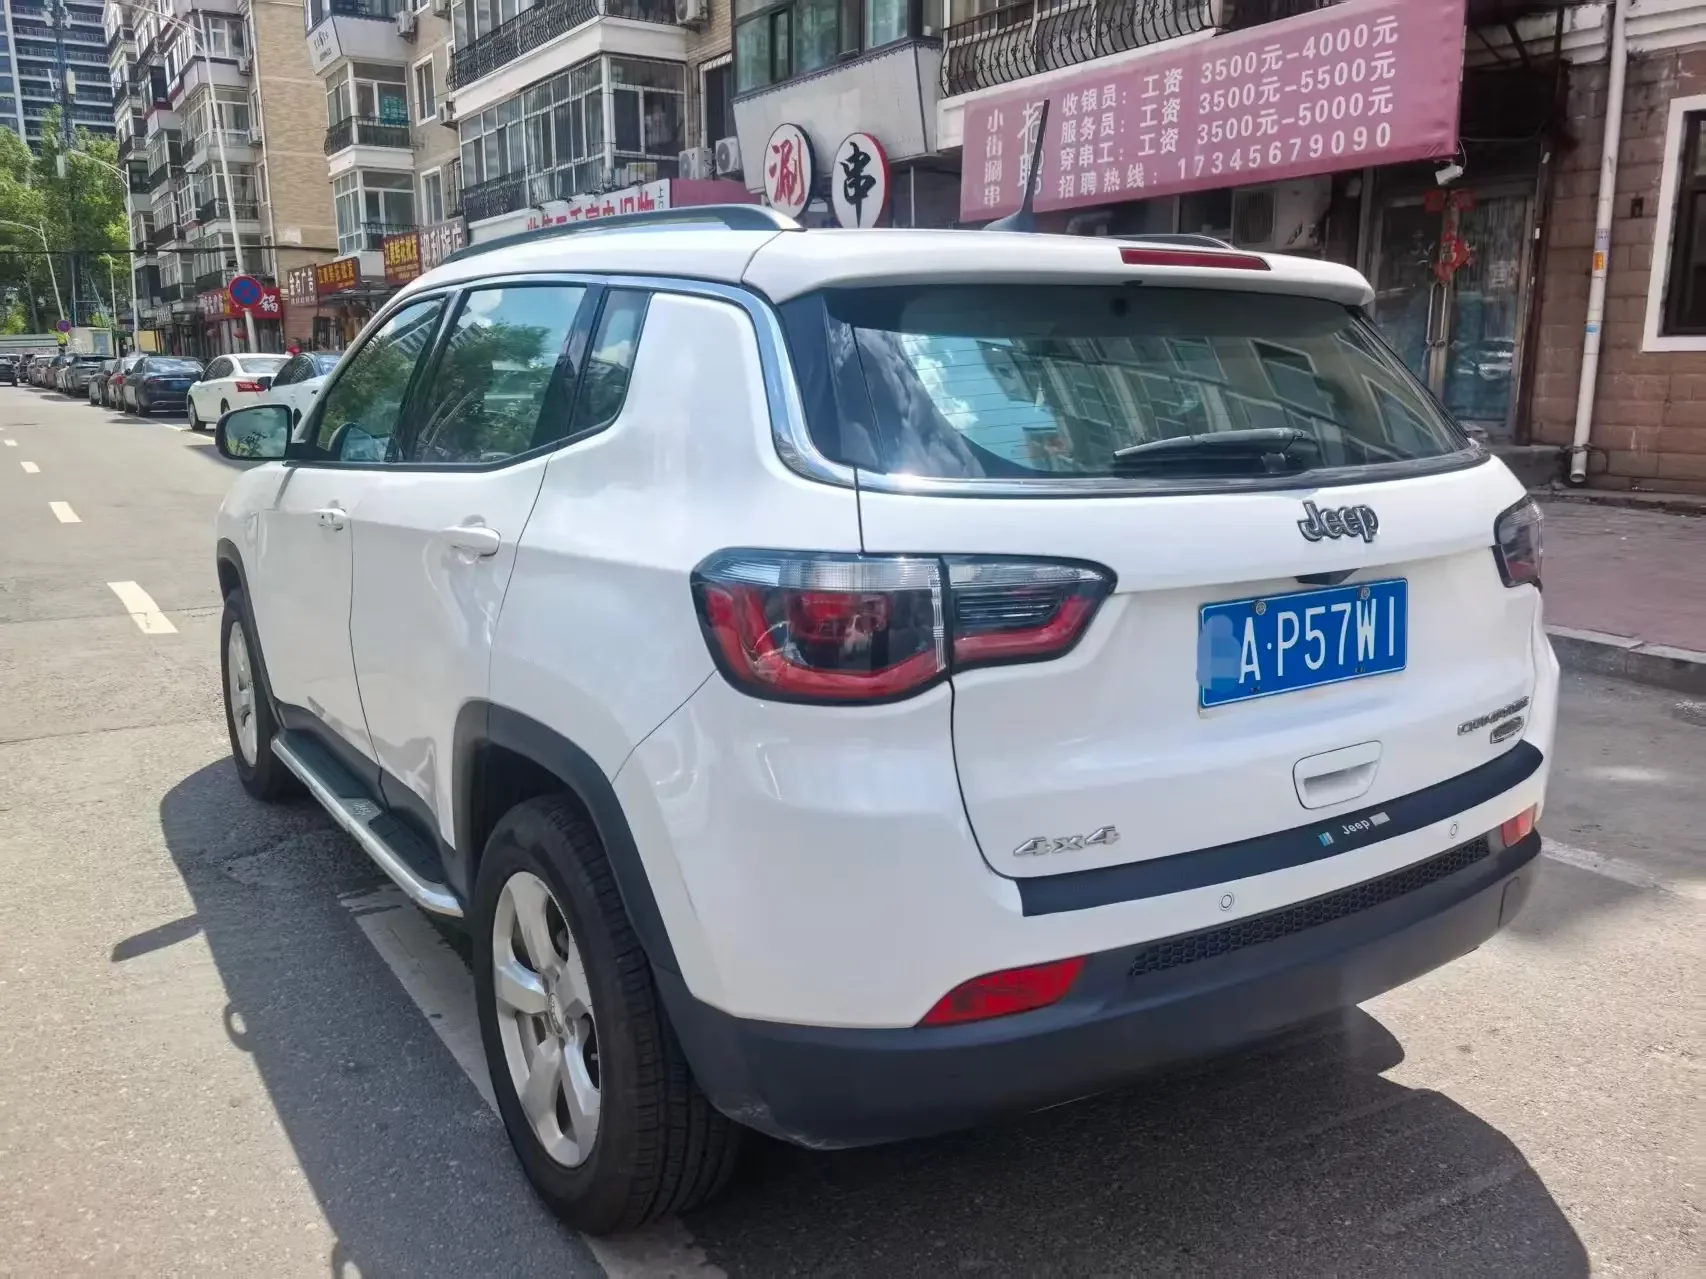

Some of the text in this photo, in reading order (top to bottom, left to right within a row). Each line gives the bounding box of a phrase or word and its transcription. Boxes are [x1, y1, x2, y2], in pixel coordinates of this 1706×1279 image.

[1140, 98, 1181, 127] 工资
[1199, 50, 1396, 115] 3500元-5500元
[1141, 68, 1184, 98] 工资
[1201, 15, 1398, 84] 3500元-4000元
[1138, 127, 1179, 156] 工资
[1197, 85, 1394, 146] 3500元-5000元
[1177, 122, 1391, 180] 17345679090
[769, 134, 877, 228] 涮 串
[1297, 500, 1380, 543] Jeep
[1239, 596, 1395, 684] A·P57W1
[1341, 819, 1370, 835] Jeep
